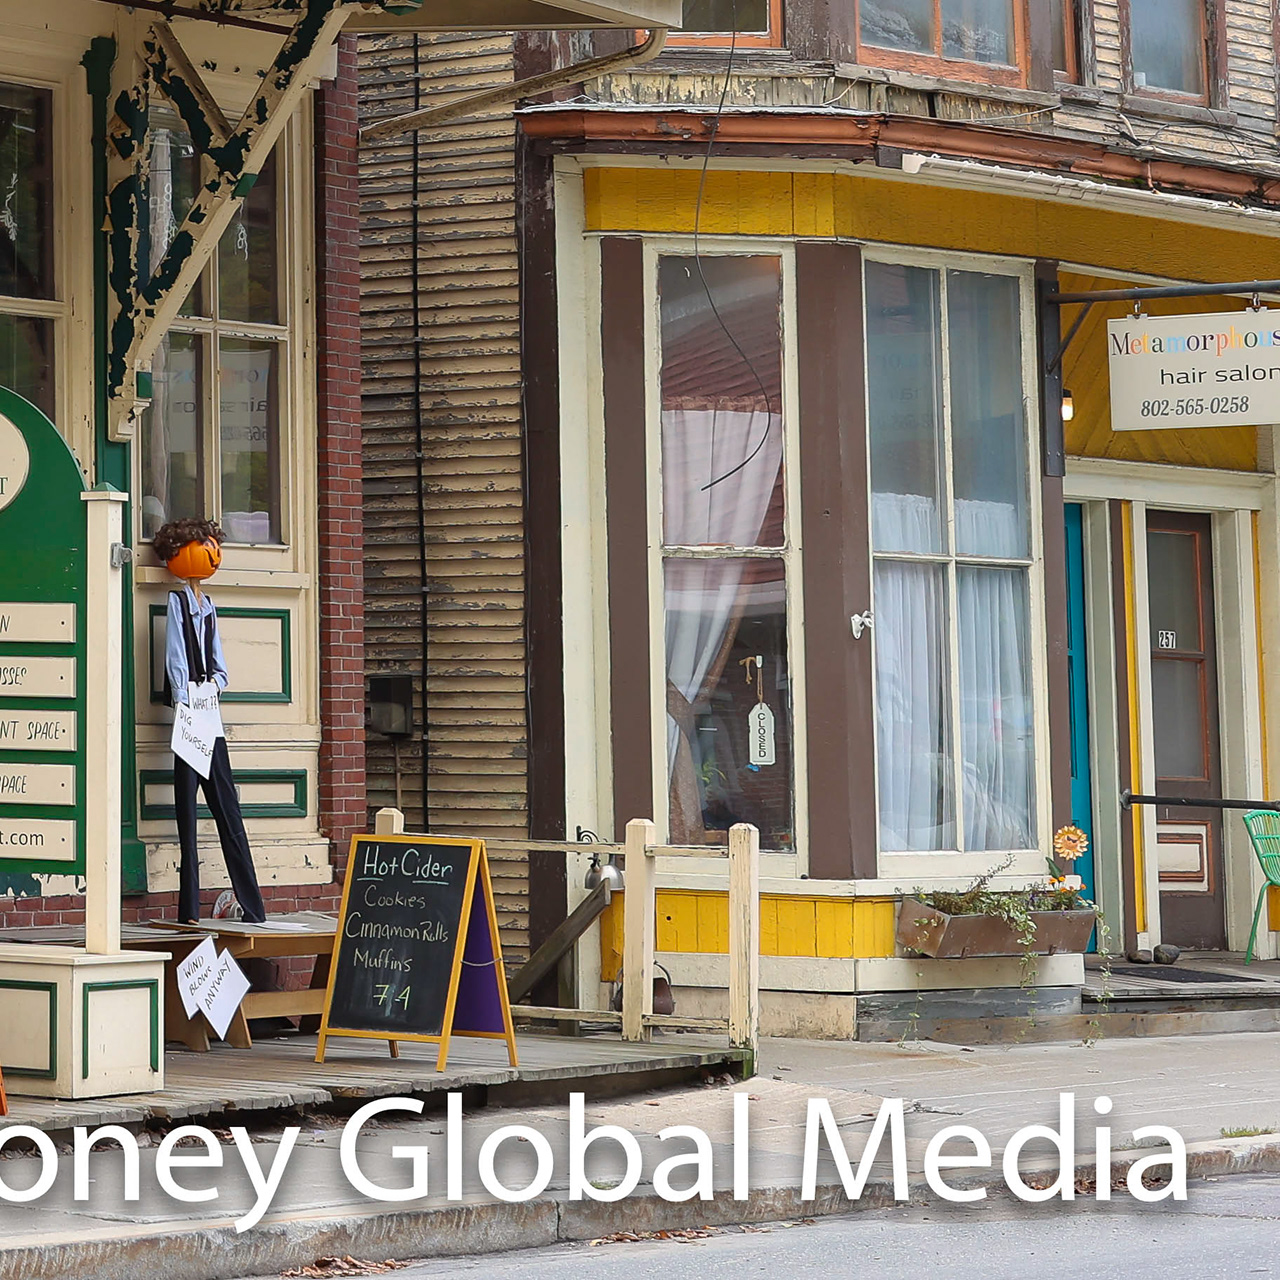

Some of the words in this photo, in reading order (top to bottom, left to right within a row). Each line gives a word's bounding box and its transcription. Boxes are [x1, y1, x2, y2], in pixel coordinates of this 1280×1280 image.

[1110, 325, 1280, 357] Metamorphous
[1160, 367, 1207, 385] hair
[1215, 364, 1280, 384] salon
[1141, 396, 1249, 418] 802-565-0258
[1159, 631, 1175, 649] 257
[179, 709, 192, 727] DIG
[27, 721, 61, 741] SPACE
[757, 712, 767, 758] CLOSED
[363, 845, 398, 877] Hot
[400, 848, 453, 879] Cider
[364, 883, 426, 909] Cookies
[183, 955, 204, 979] WIND
[353, 947, 414, 973] Muffins
[204, 958, 232, 1011] ANYWAY
